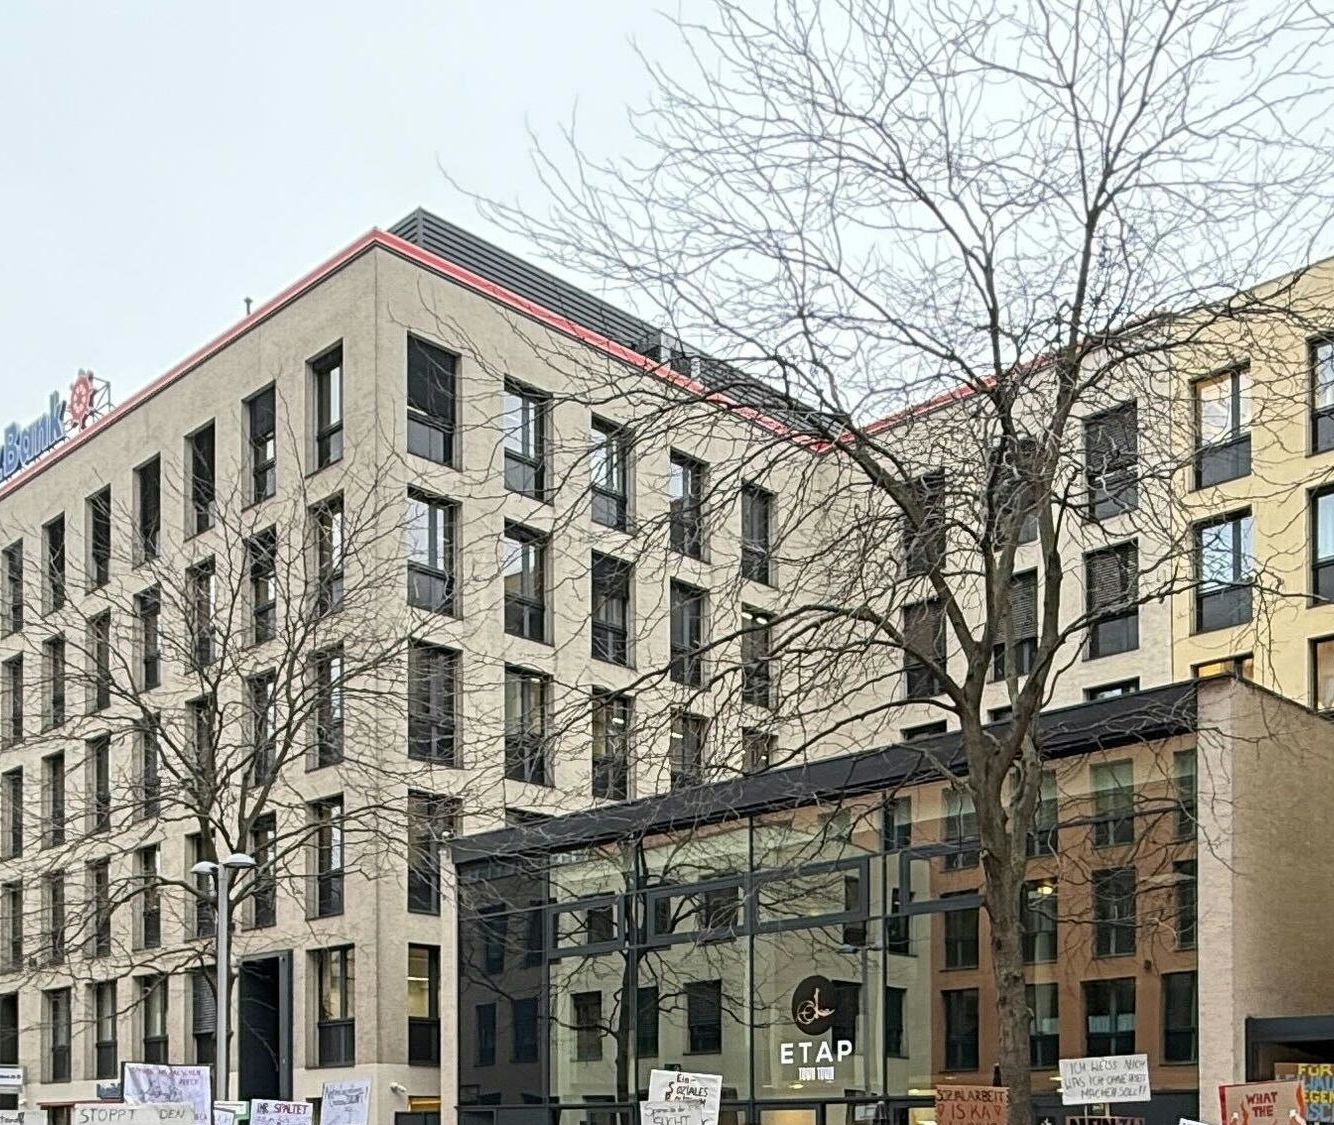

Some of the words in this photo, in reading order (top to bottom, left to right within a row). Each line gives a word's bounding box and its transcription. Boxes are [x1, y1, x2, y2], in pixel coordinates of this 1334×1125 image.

[780, 1039, 853, 1064] ETAP
[1297, 1063, 1334, 1077] FÜR
[1245, 1091, 1278, 1104] WHAT
[79, 1107, 136, 1124] STOPPT
[159, 1107, 185, 1120] DEN
[274, 1103, 309, 1115] SPALTET
[951, 1103, 966, 1120] IS
[970, 1103, 992, 1120] KA
[1252, 1106, 1274, 1118] THE
